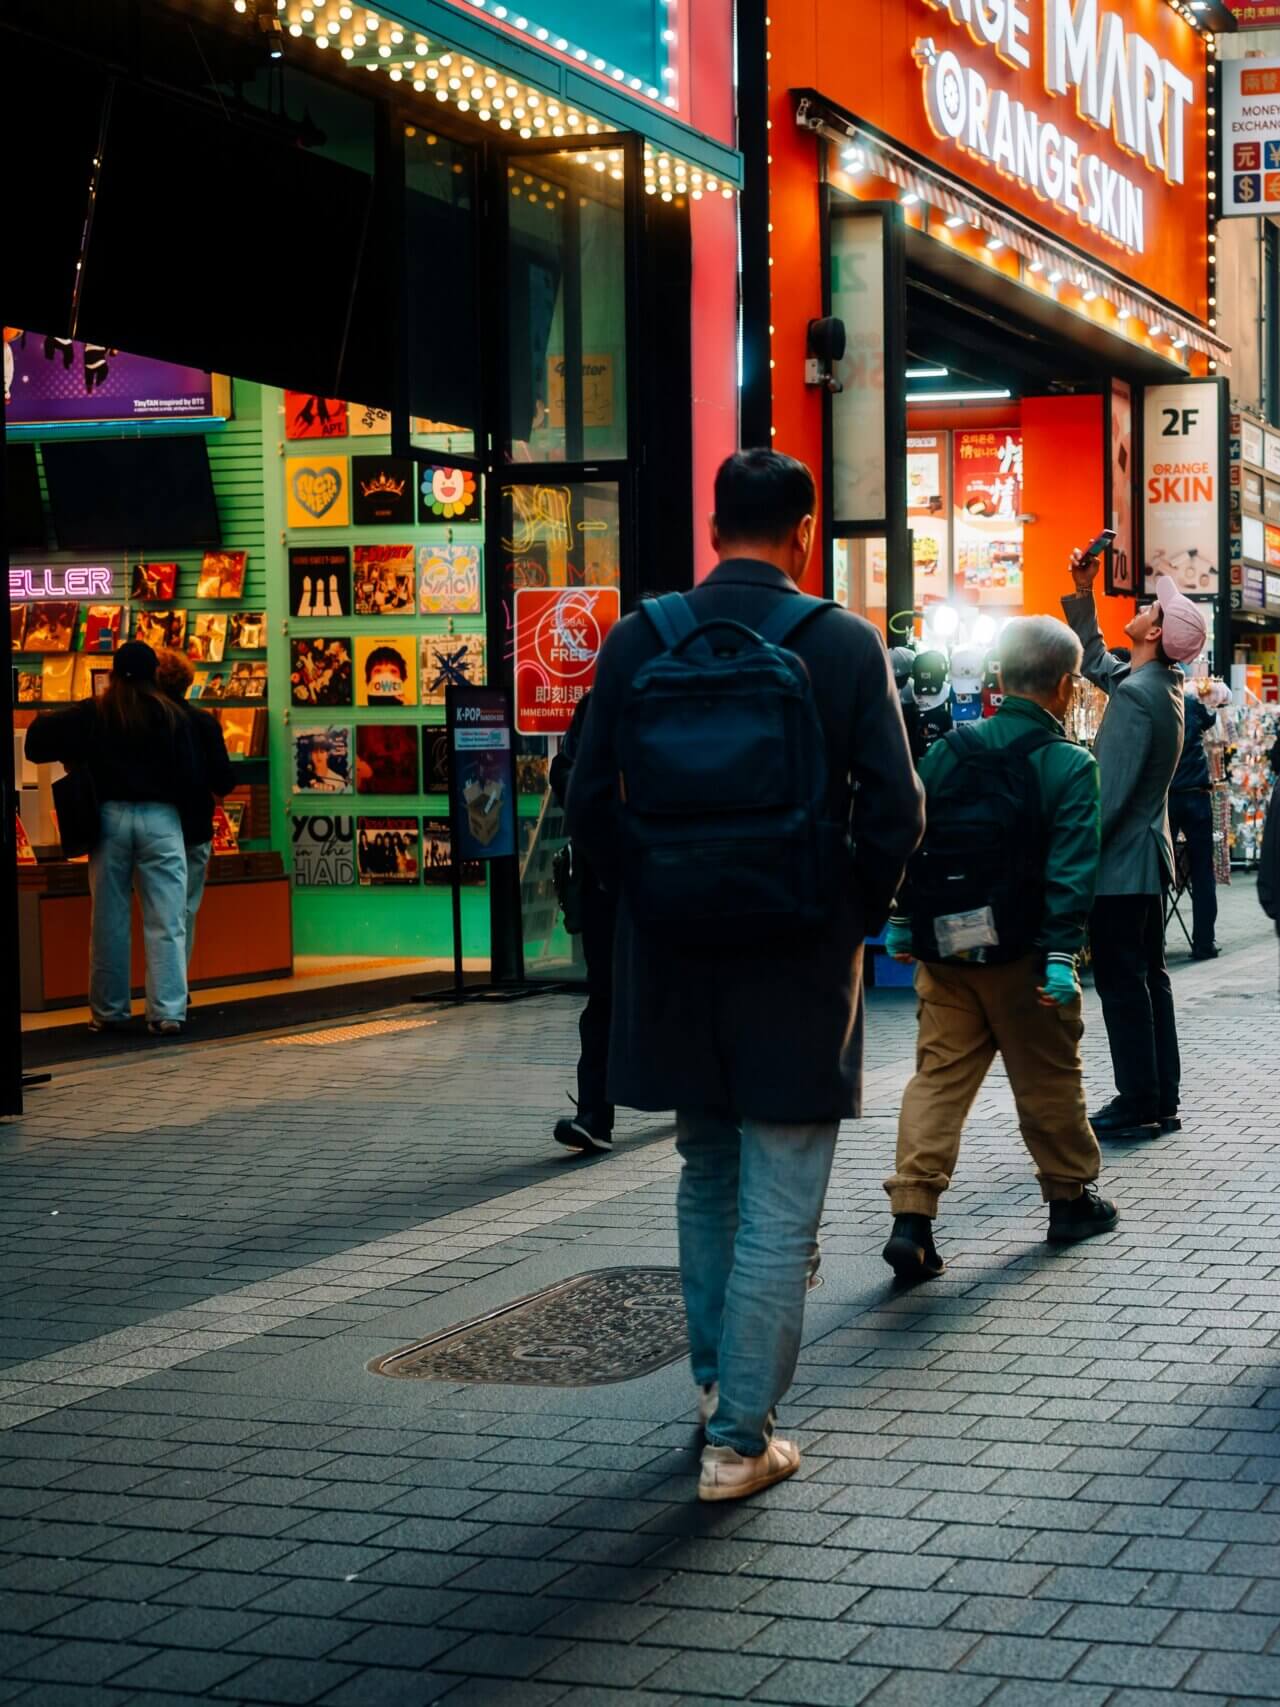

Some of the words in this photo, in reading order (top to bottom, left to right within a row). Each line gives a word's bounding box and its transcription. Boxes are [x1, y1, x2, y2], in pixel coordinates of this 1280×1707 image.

[923, 49, 1080, 215] ORANGE
[1079, 152, 1145, 255] SKIN
[1161, 408, 1200, 437] 2F
[1152, 462, 1209, 476] ORANGE
[1148, 475, 1214, 504] SKIN
[548, 628, 589, 647] TAX
[550, 648, 589, 663] FREE
[520, 708, 564, 717] IMMEDIATE
[293, 815, 354, 842] YOU
